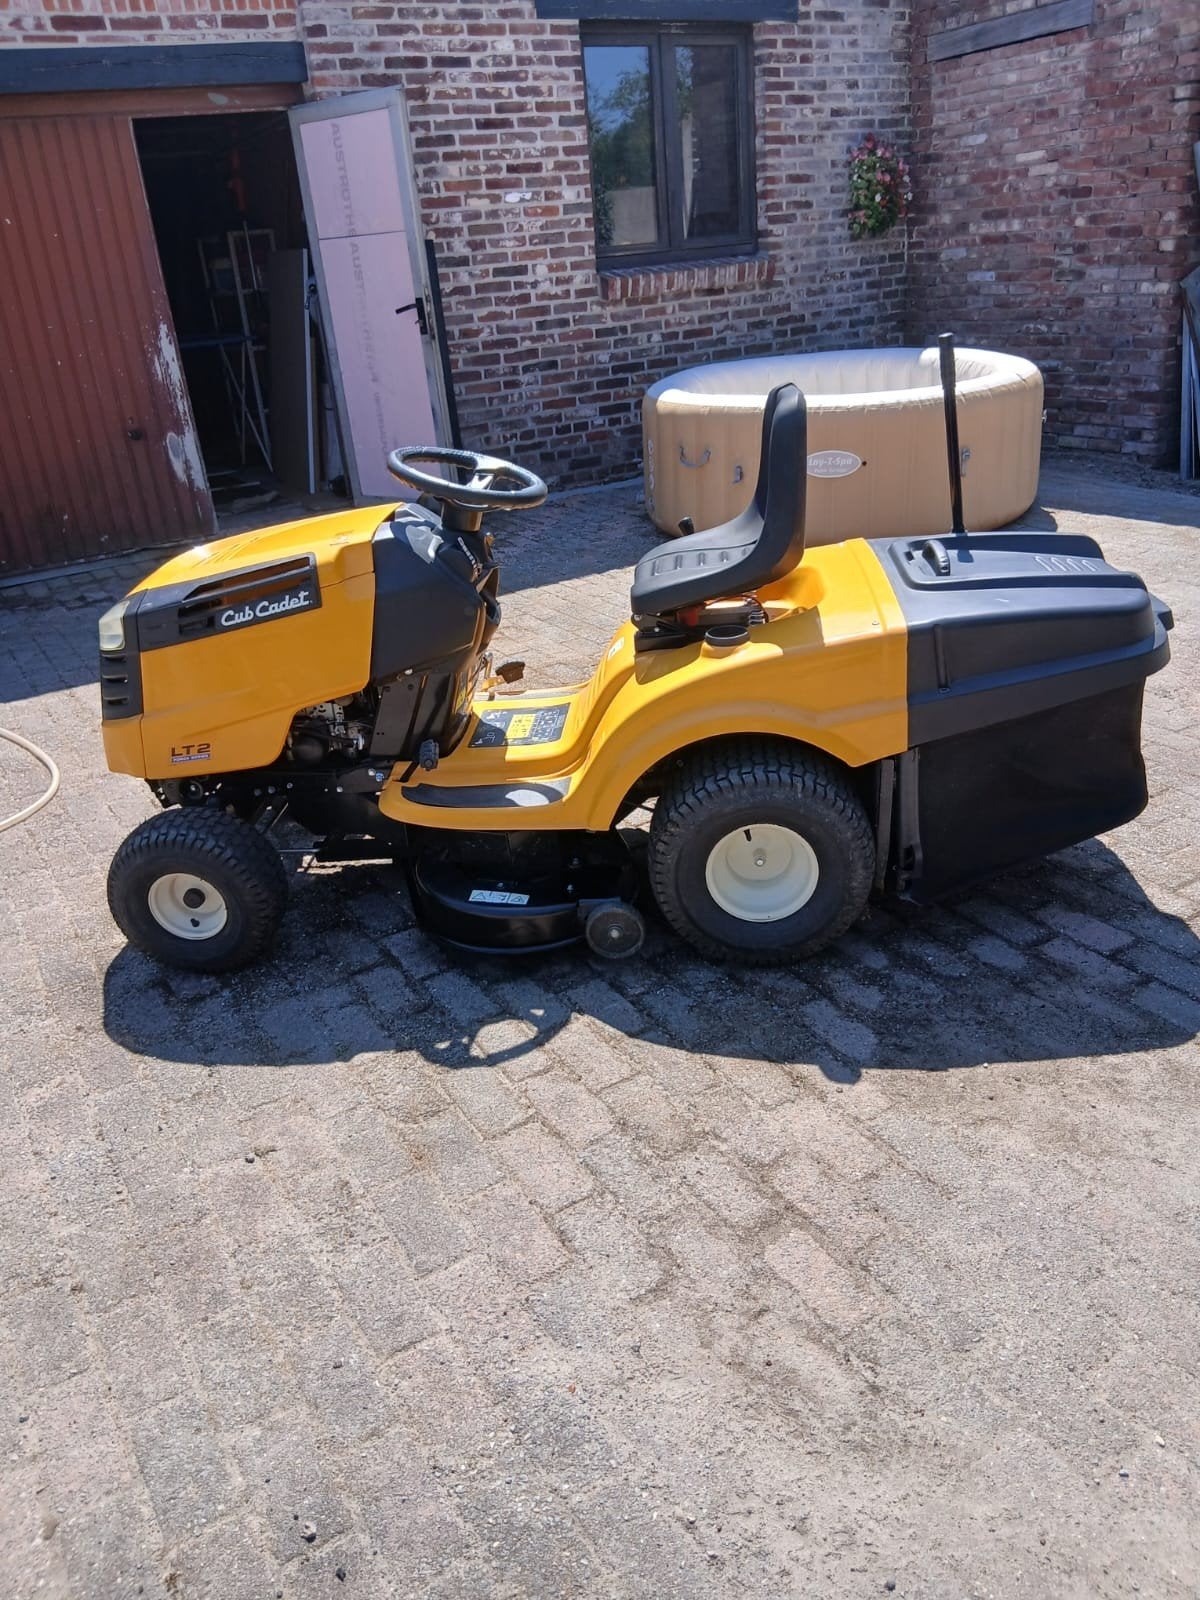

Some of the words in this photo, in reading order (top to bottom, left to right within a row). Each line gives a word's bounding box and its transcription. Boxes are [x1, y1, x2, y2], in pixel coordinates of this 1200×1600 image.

[221, 606, 255, 626] Cub
[255, 591, 310, 617] Cadet
[171, 743, 211, 756] LT2
